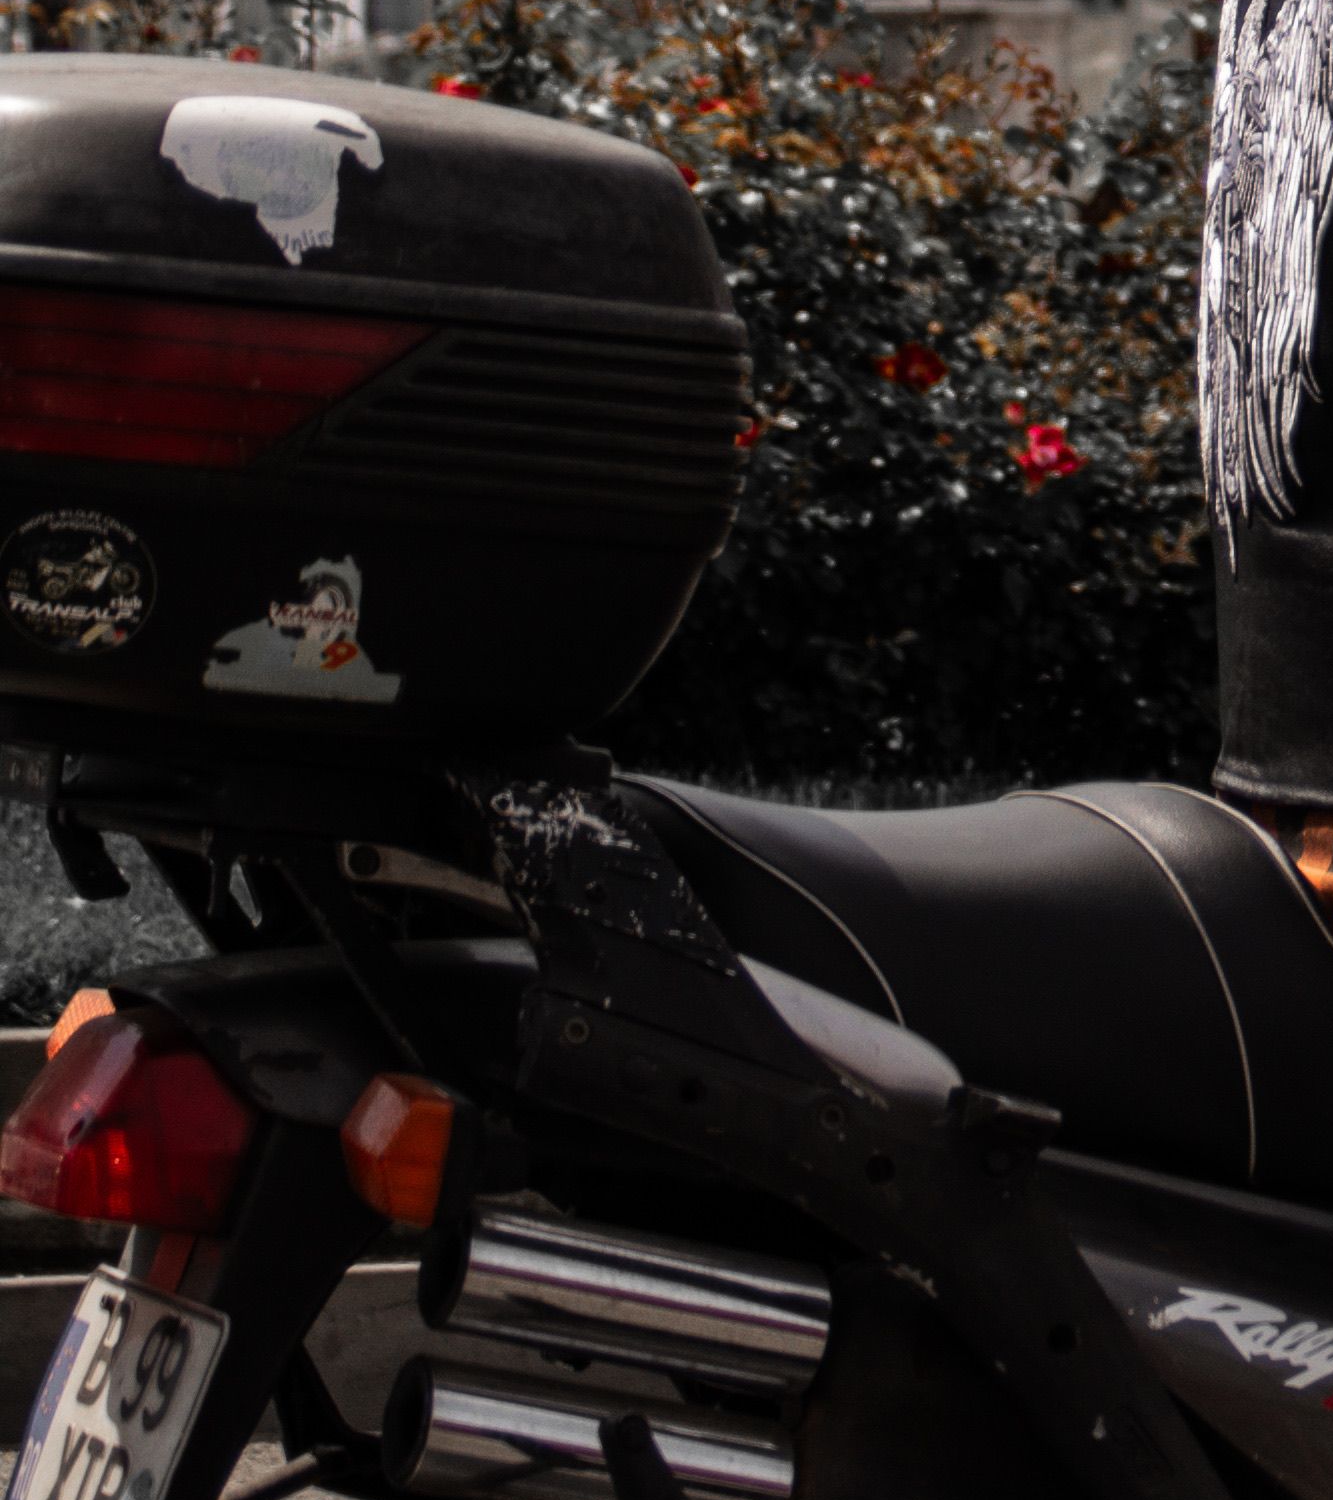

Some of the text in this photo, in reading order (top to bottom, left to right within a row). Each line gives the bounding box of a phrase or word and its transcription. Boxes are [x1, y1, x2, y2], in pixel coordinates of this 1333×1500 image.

[9, 595, 135, 622] TRANSALP
[76, 1294, 191, 1431] B 99
